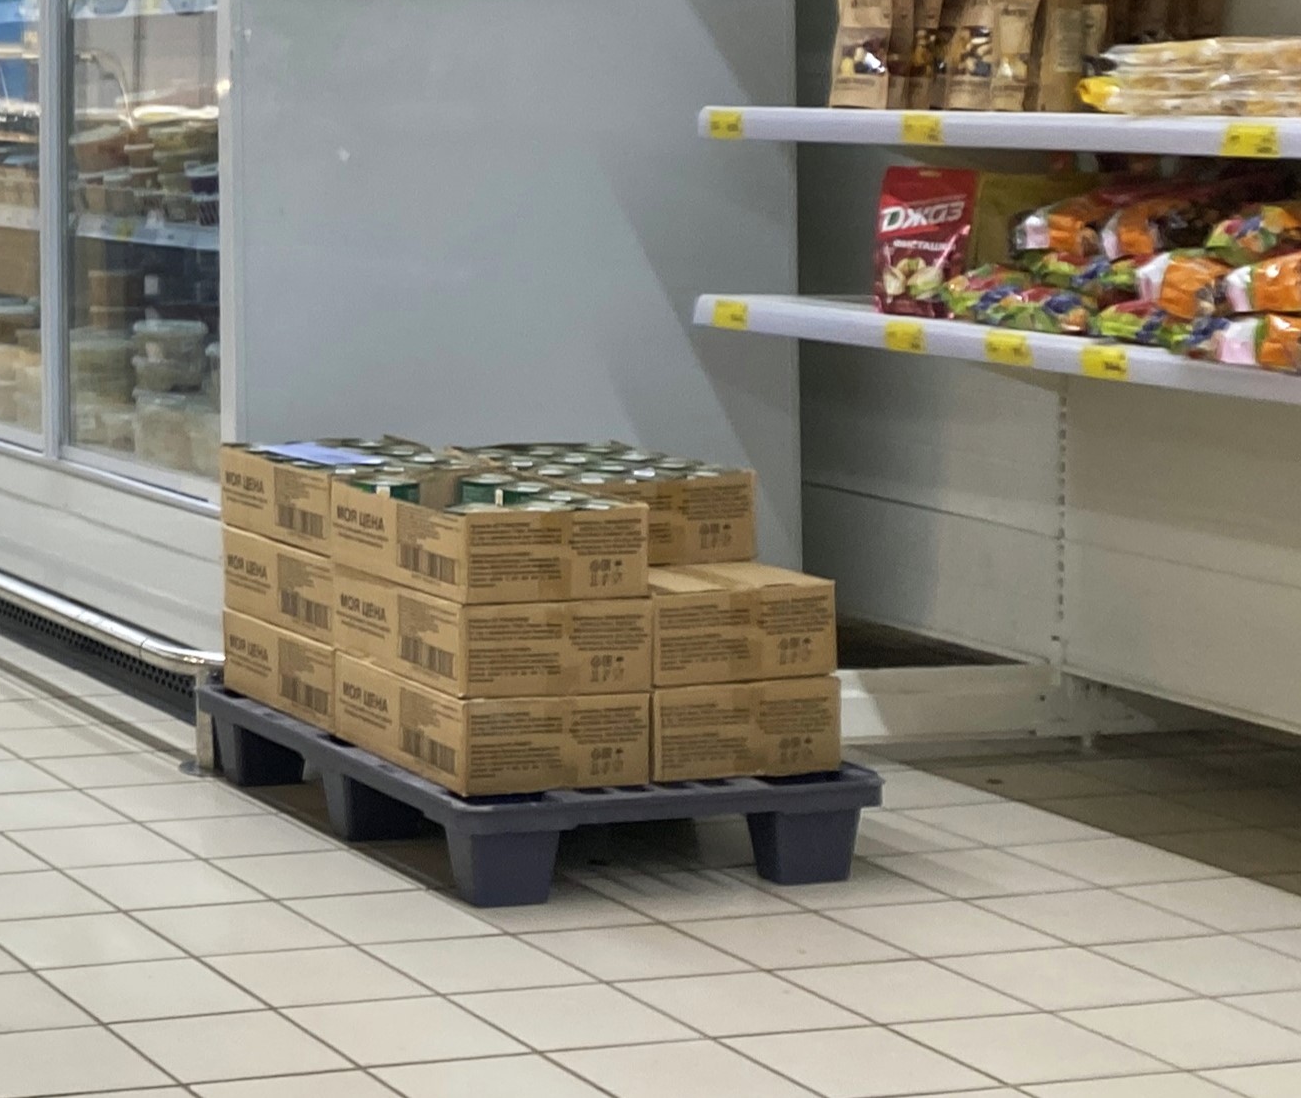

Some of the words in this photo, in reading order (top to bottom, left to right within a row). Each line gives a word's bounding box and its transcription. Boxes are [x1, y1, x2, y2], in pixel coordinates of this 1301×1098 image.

[243, 476, 265, 494] ЦЕНА
[358, 510, 385, 532] ЦЕНА
[246, 559, 268, 580] ЦЕНА
[362, 600, 387, 622] ЦЕНА
[247, 640, 269, 661] ЦЕНА
[363, 690, 388, 713] ЦЕНА
